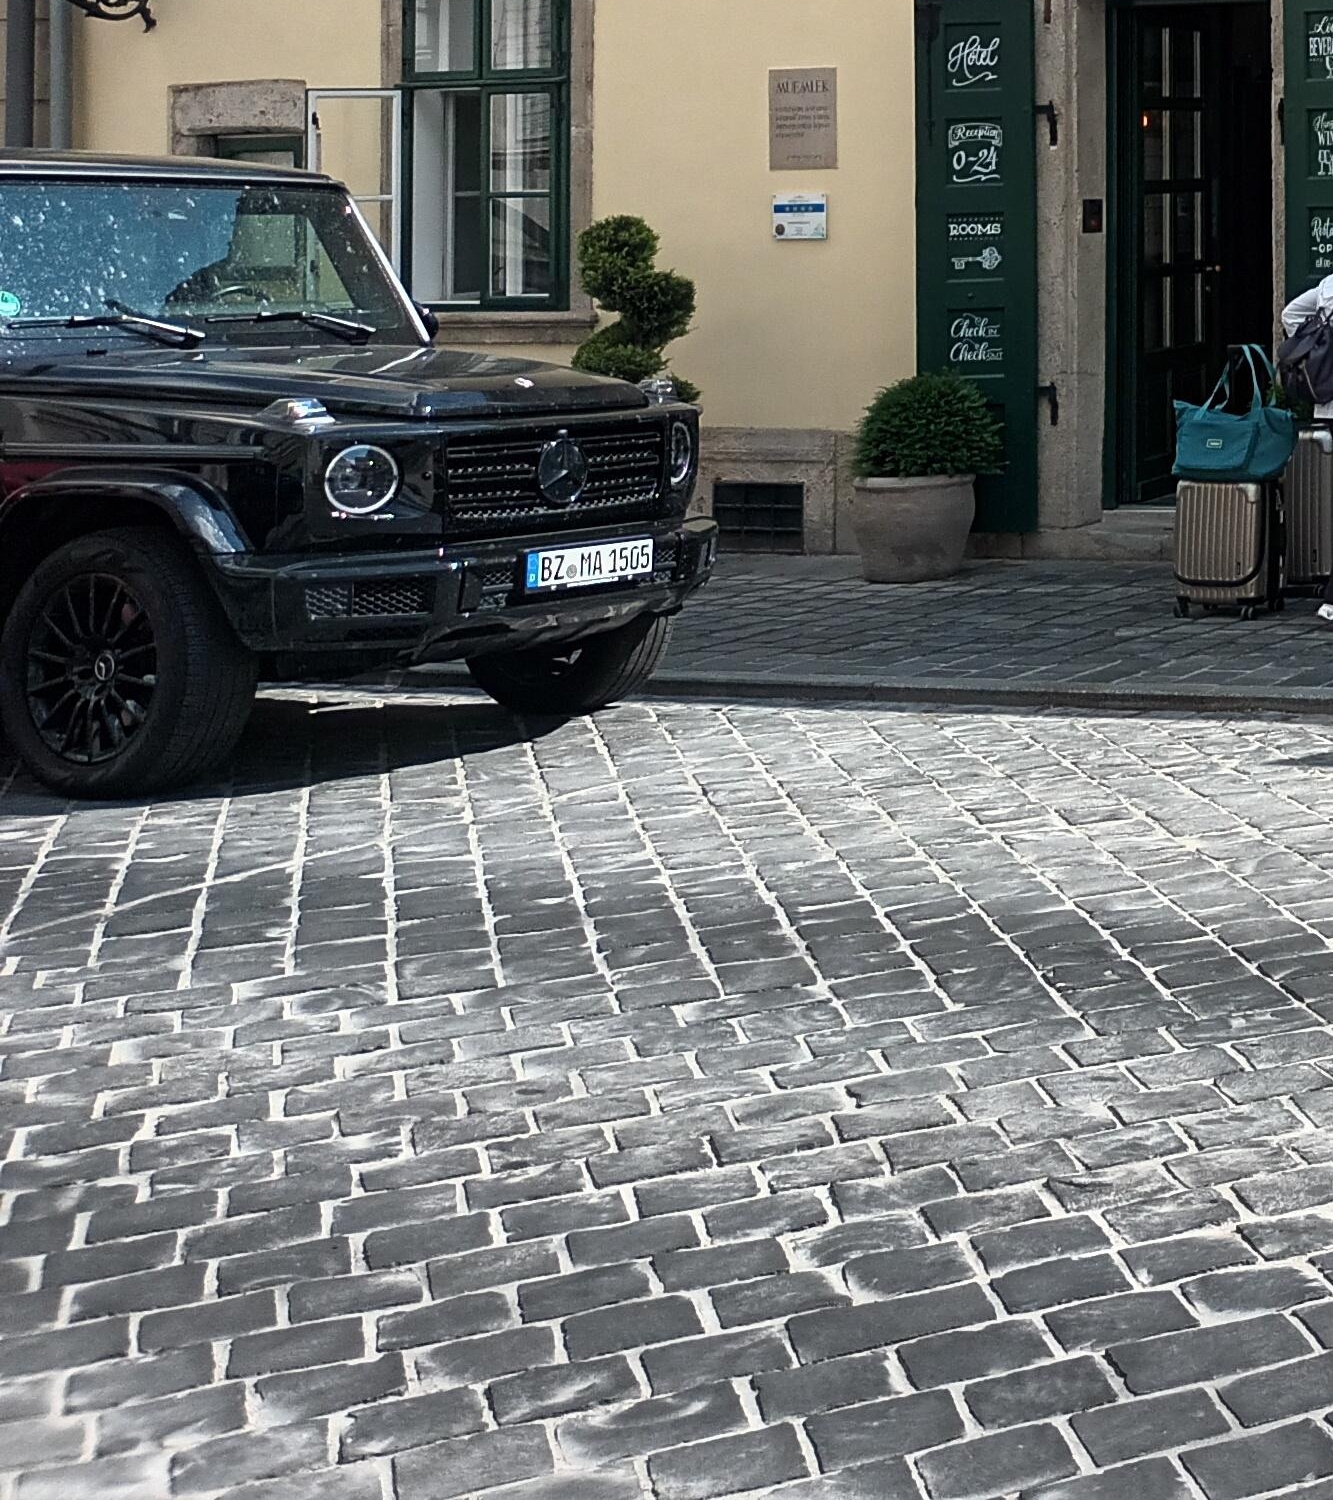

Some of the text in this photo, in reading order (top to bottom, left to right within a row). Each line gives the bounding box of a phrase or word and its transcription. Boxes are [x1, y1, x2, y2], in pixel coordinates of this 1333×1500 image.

[947, 35, 1001, 79] Hotel
[952, 124, 999, 142] Reception
[952, 146, 999, 175] 0-24
[948, 223, 1002, 237] ROOMS
[950, 313, 988, 338] Check
[950, 338, 988, 362] Check
[541, 544, 650, 582] BZ MA 1505
